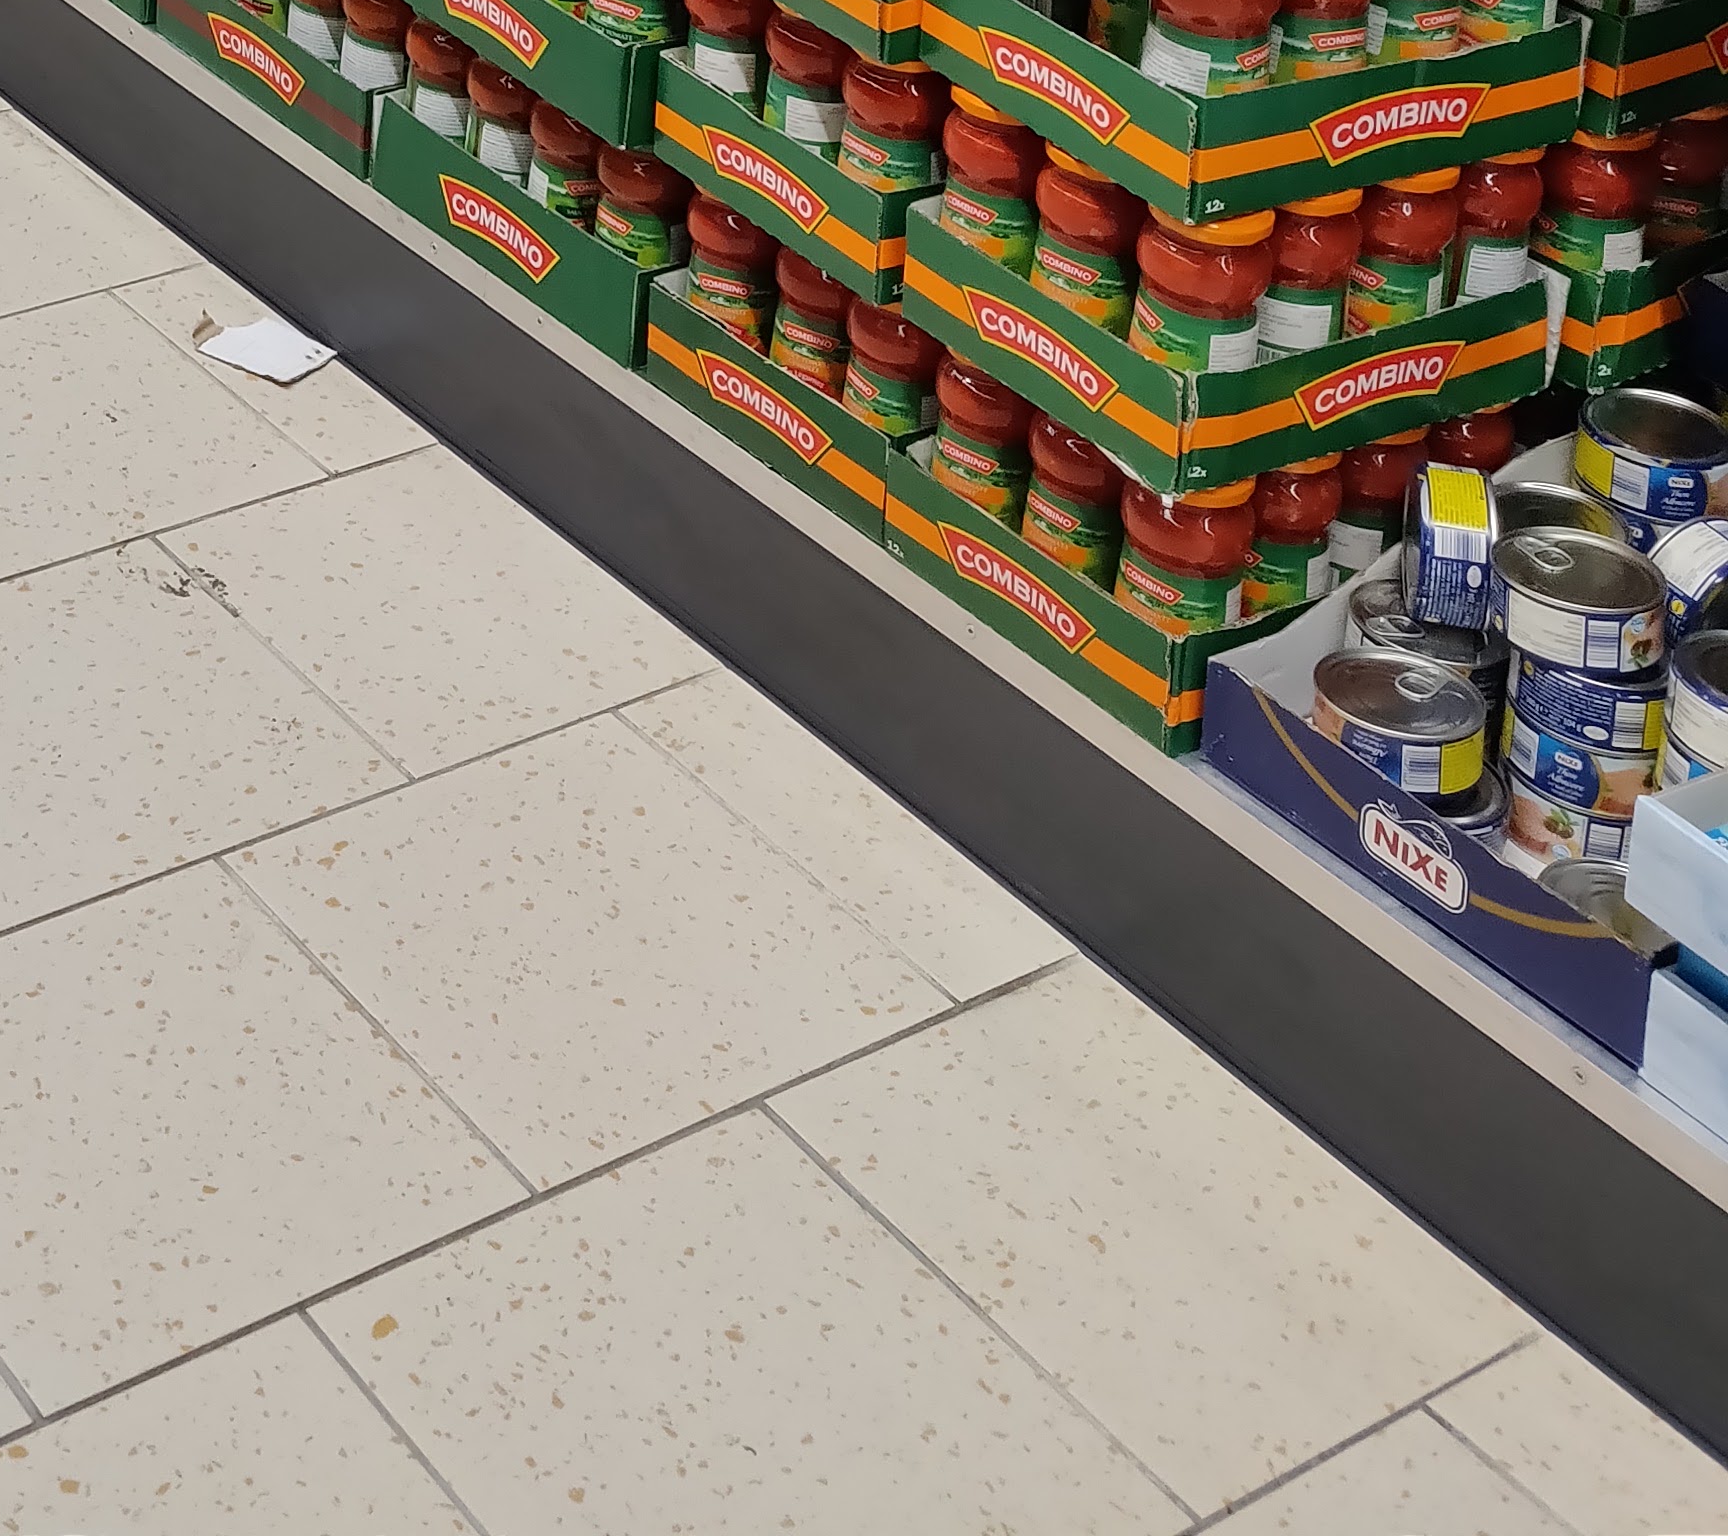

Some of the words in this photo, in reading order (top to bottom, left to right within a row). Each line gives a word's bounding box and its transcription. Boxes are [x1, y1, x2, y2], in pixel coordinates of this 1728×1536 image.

[995, 46, 1110, 128] COMBINO
[1332, 97, 1467, 147] COMBINO
[1314, 356, 1443, 412] COMBINO
